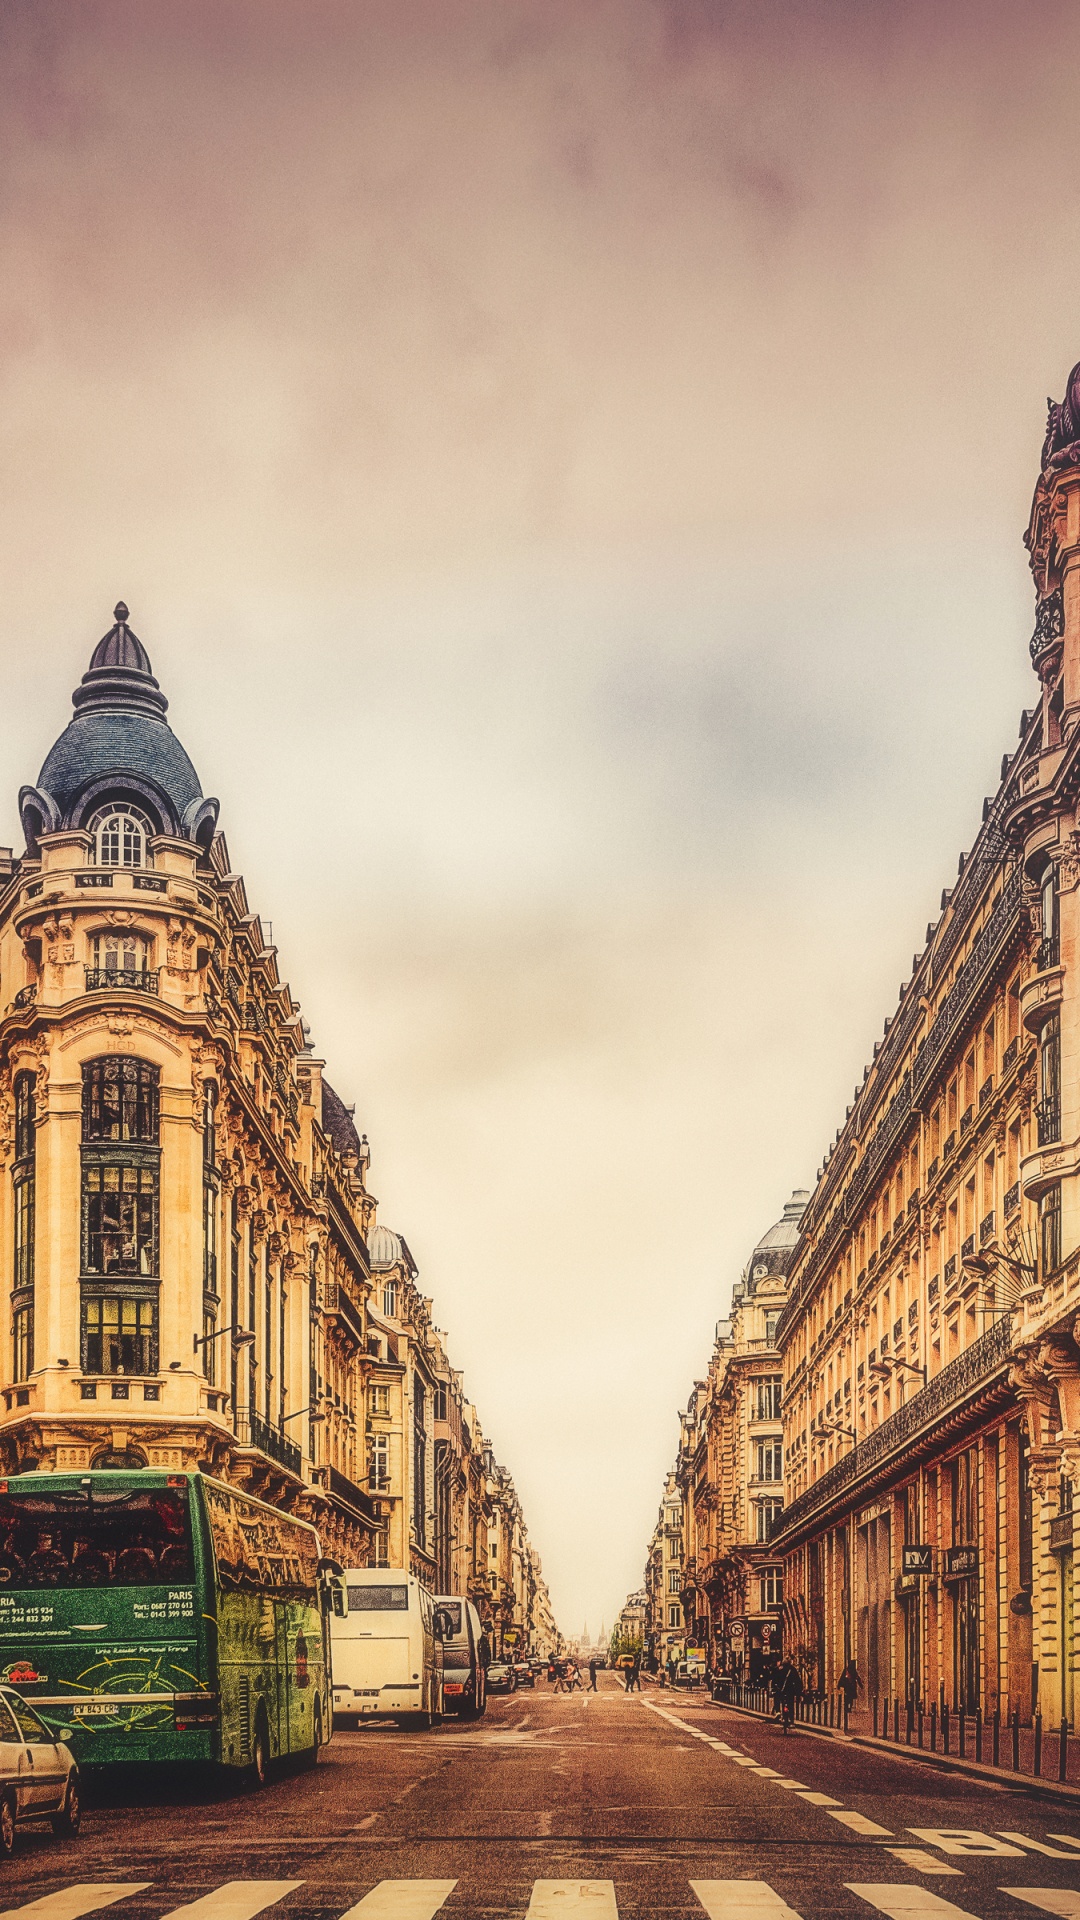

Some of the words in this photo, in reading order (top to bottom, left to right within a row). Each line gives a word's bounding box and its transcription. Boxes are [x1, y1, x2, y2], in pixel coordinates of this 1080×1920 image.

[168, 1591, 193, 1600] PARIS
[74, 1705, 84, 1714] CW
[87, 1705, 102, 1713] 843
